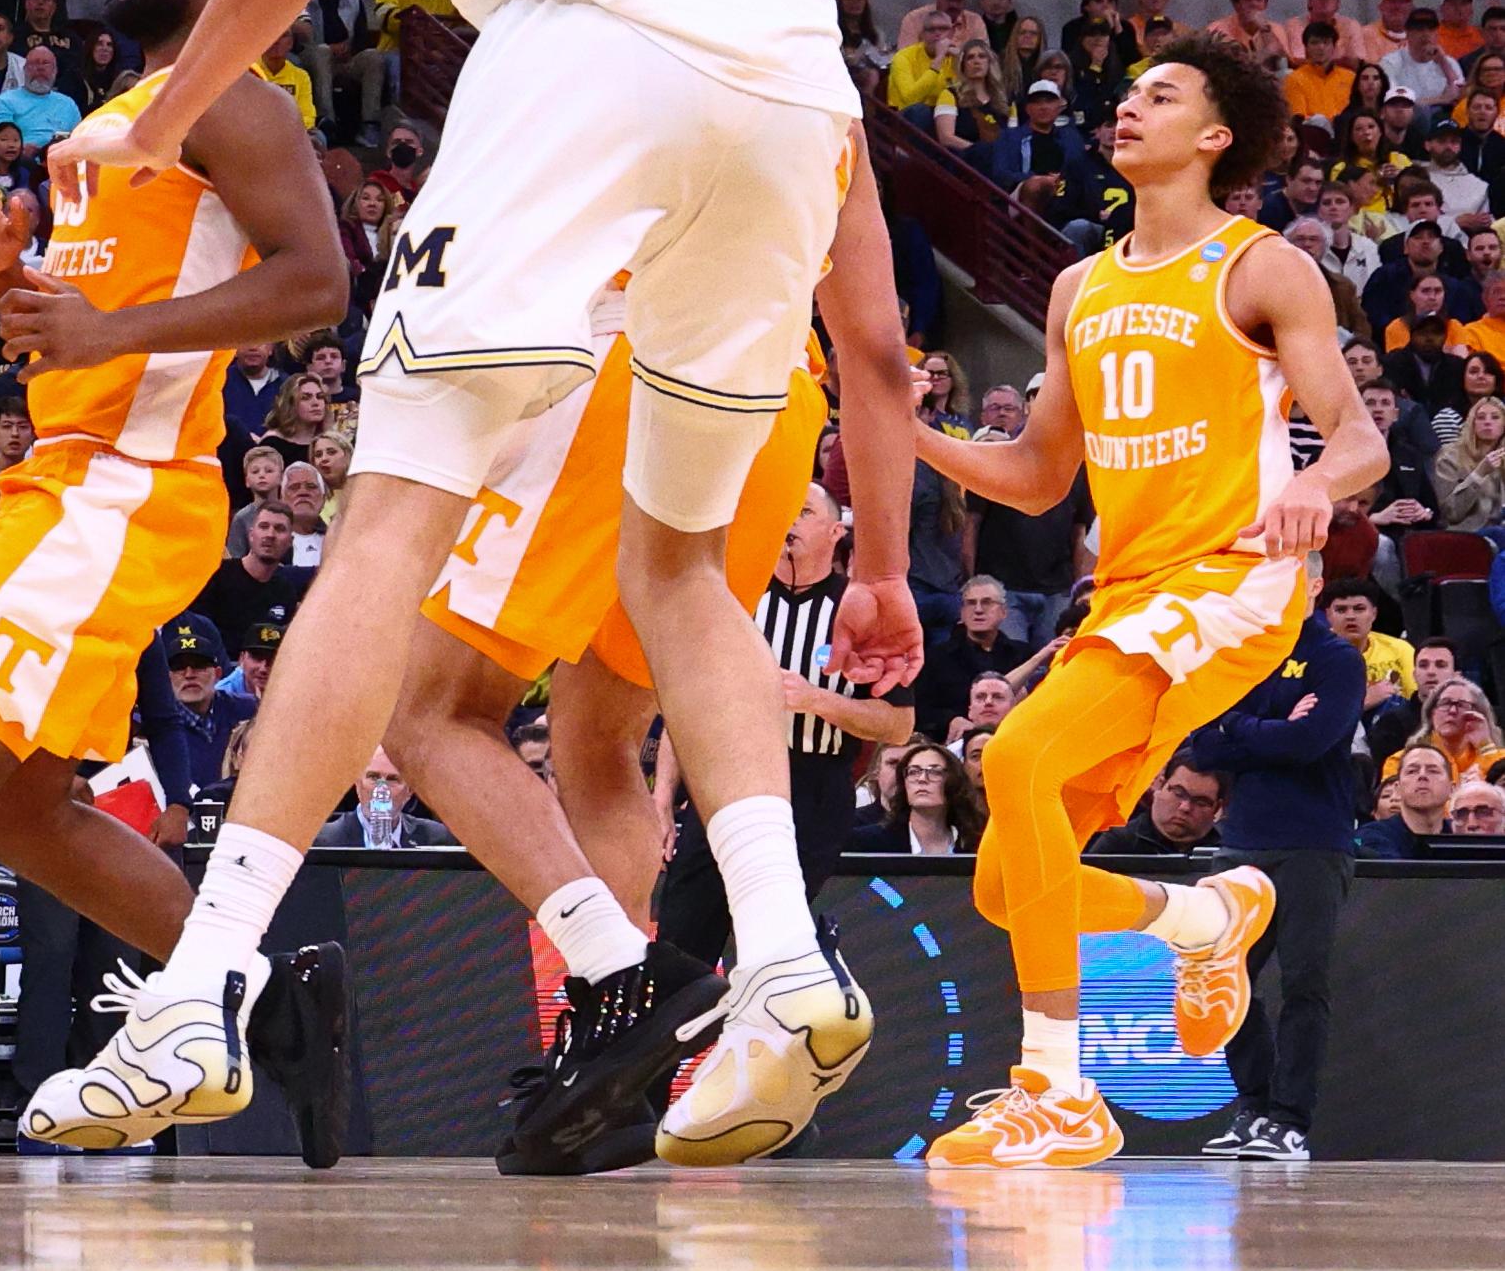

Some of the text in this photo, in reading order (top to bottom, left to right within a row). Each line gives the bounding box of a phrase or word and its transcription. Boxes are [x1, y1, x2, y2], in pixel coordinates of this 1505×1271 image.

[385, 227, 457, 292] M
[1074, 303, 1200, 355] TENNESSEE
[1099, 350, 1155, 420] 10
[452, 486, 523, 566] T
[181, 638, 195, 648] M
[1150, 599, 1203, 665] T
[1282, 660, 1307, 678] M
